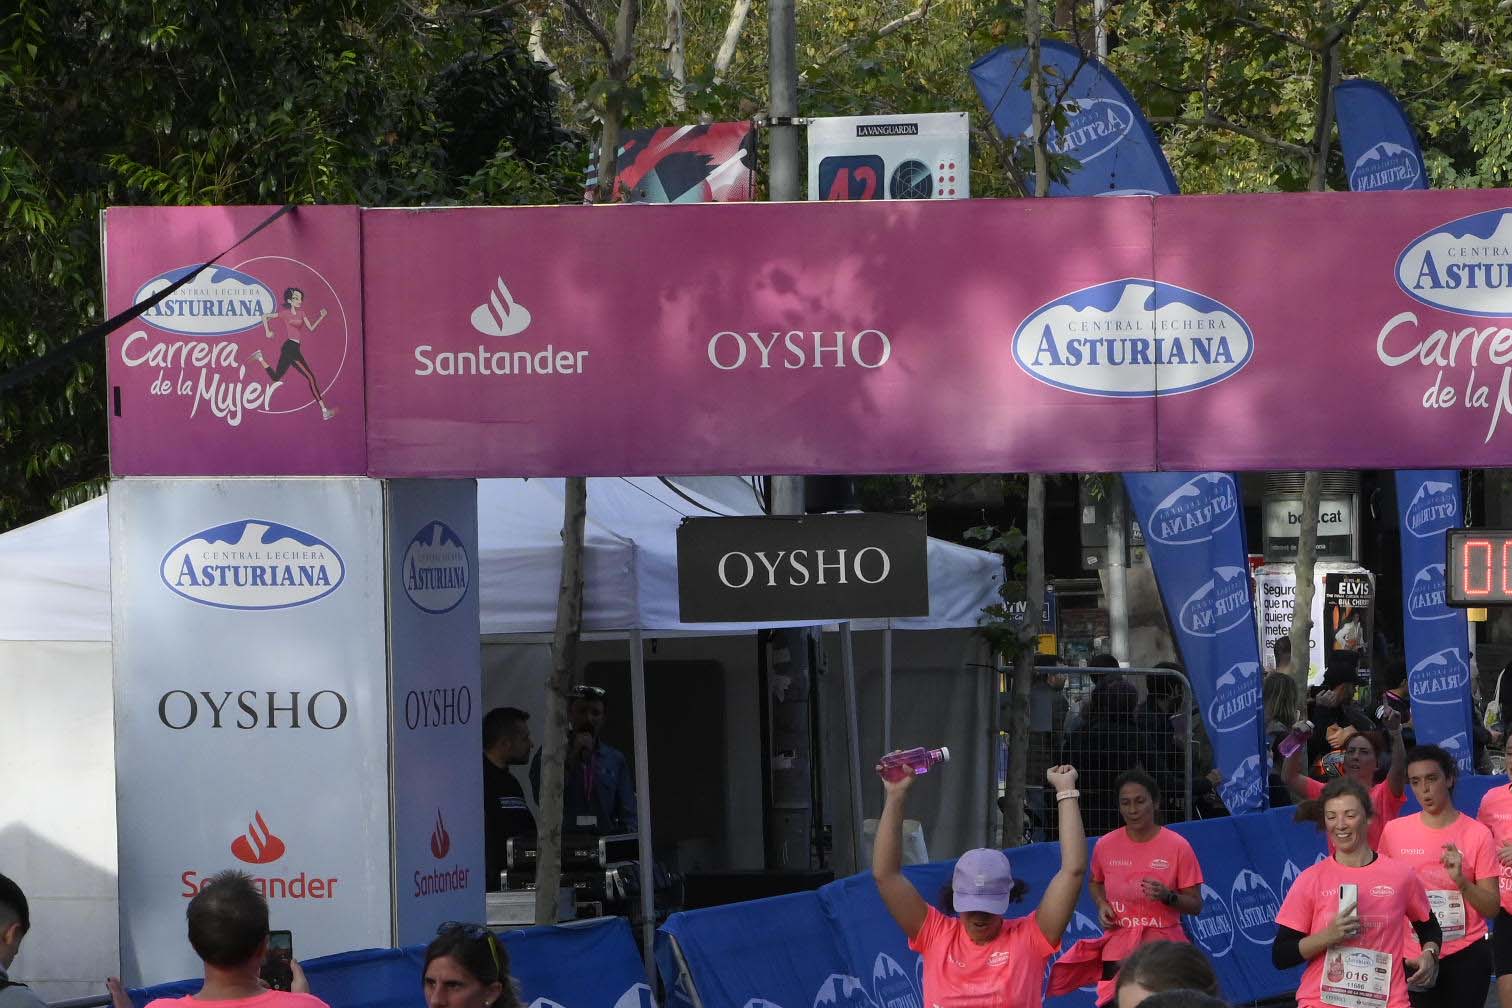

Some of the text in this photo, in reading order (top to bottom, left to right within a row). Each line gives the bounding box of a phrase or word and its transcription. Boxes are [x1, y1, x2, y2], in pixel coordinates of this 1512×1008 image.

[146, 288, 265, 317] ASTURIANA
[169, 287, 213, 297] ENTRAL
[1068, 319, 1226, 332] CENTRAL LECHERA
[121, 330, 239, 367] Carrera
[415, 345, 590, 376] Santander
[707, 330, 892, 371] OYSHO
[1031, 322, 1236, 366] ASTURIANA
[151, 365, 283, 427] de la Mujer
[1422, 370, 1456, 408] de
[1464, 367, 1490, 408] la
[175, 552, 332, 587] ASTURIANA
[203, 551, 326, 560] CENTRAL LECHERA
[407, 553, 466, 591] ASTURIANA
[717, 547, 891, 588] OYSHO
[1264, 600, 1280, 610] que
[1338, 582, 1369, 595] ELVIS
[158, 690, 348, 730] OYSHO
[405, 685, 472, 730] OYSHO
[181, 870, 338, 899] Sander
[414, 865, 470, 898] Santander
[1345, 971, 1369, 982] 016
